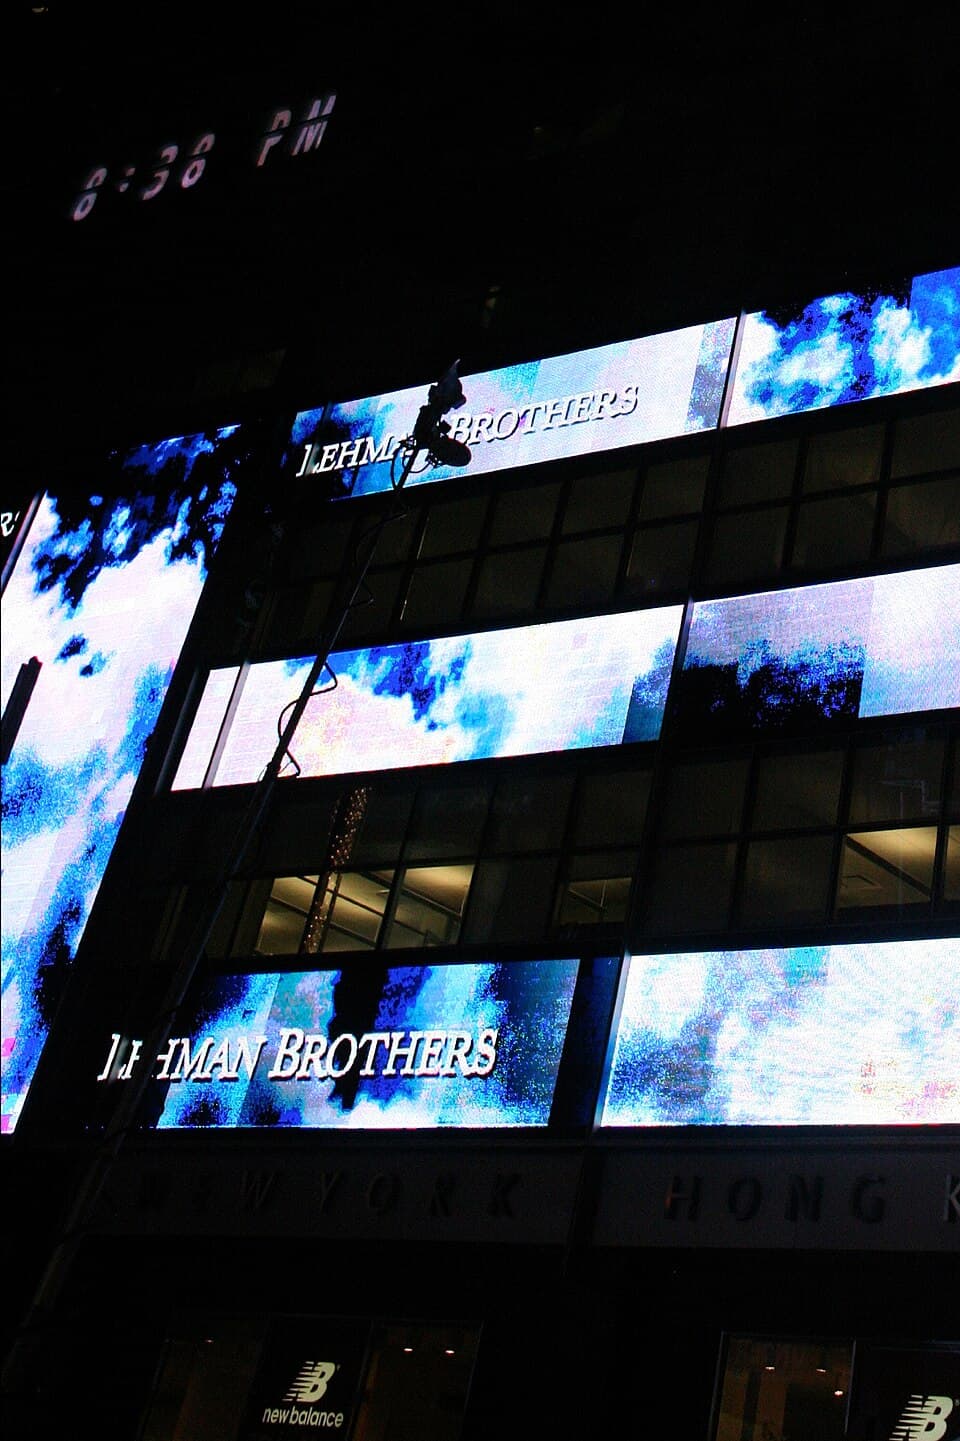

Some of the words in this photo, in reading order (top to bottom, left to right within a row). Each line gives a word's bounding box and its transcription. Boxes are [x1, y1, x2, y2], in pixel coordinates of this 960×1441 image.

[73, 133, 216, 222] 8:38
[256, 95, 337, 167] PM
[447, 385, 640, 447] BROTHERS
[267, 1027, 499, 1081] BROTHERS
[664, 1173, 888, 1226] HONG
